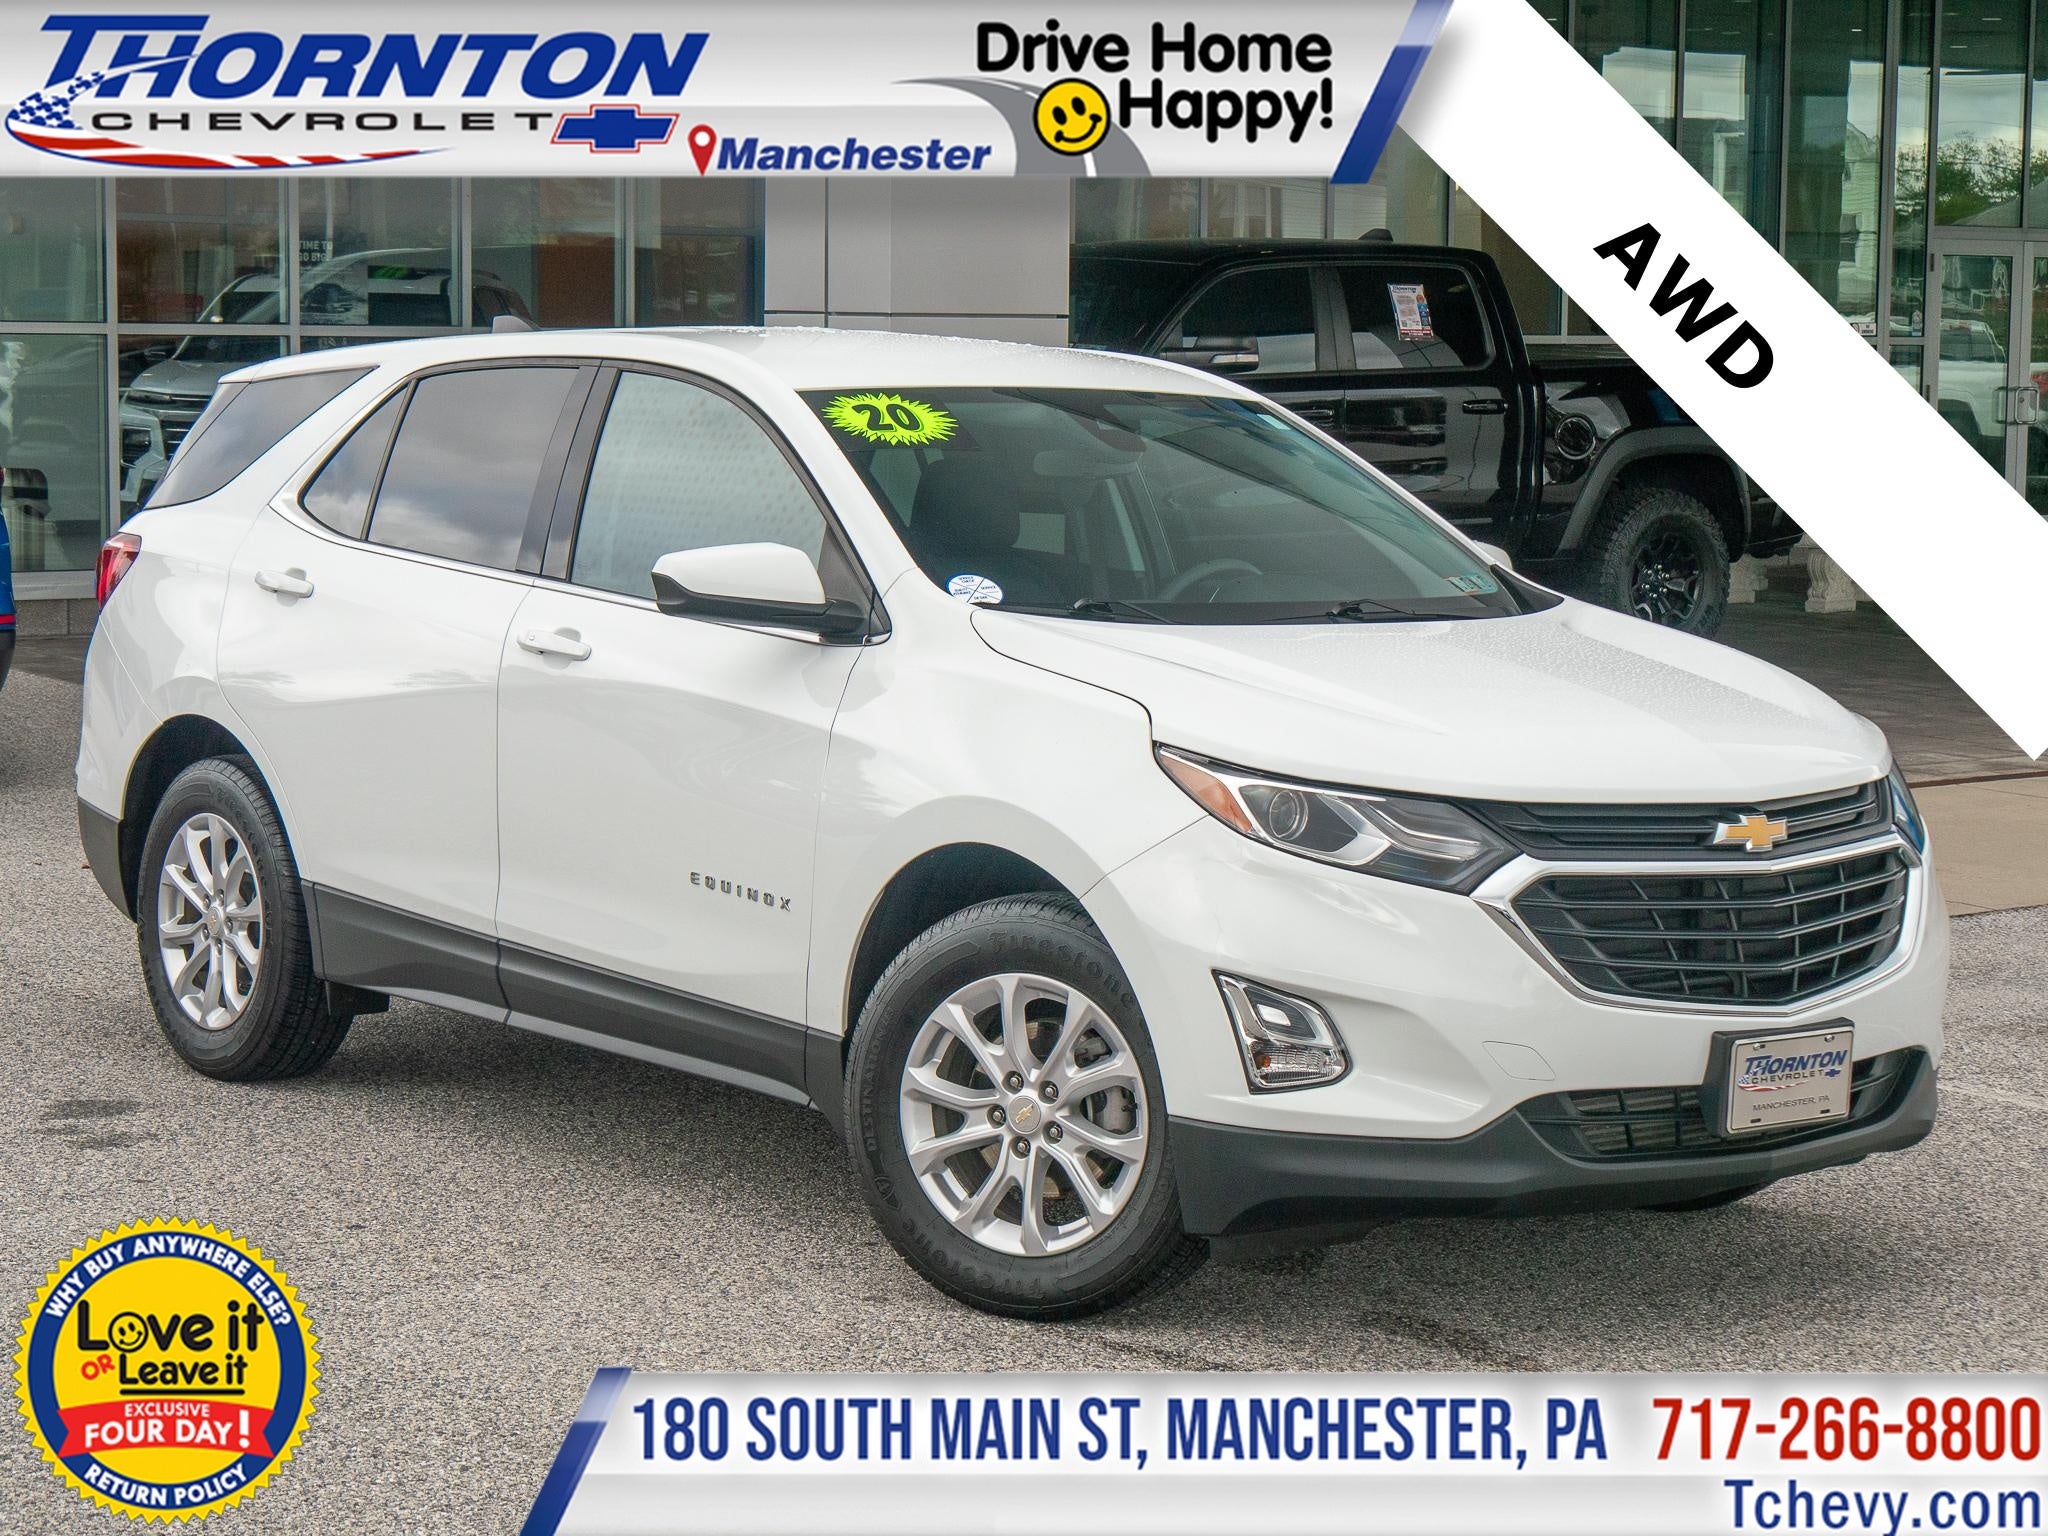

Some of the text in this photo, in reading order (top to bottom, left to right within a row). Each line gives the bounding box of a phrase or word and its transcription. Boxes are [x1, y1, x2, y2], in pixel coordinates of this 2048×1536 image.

[852, 403, 924, 431] 20
[689, 871, 791, 913] EQUINOX
[1745, 1050, 1848, 1077] THORNTON
[1751, 1069, 1823, 1085] CHEVROLET
[1752, 1094, 1830, 1112] MANCHESTER, PA
